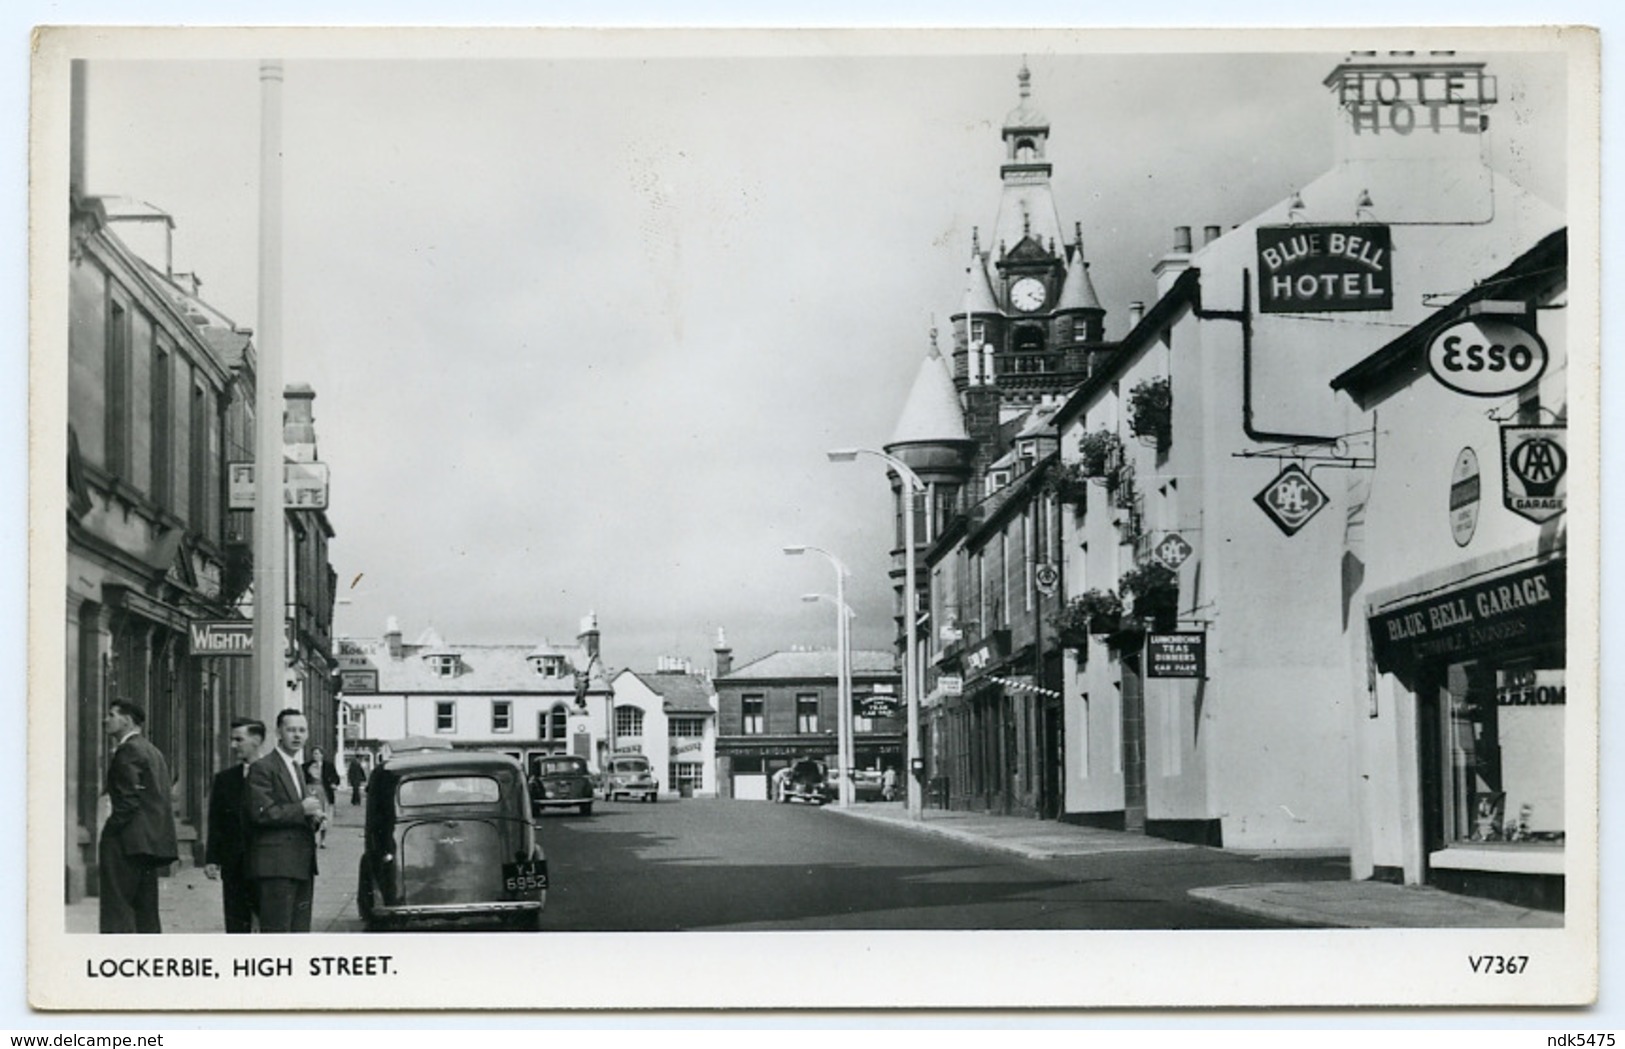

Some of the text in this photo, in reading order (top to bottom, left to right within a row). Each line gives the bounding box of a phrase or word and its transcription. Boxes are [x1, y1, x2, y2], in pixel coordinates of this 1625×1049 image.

[1340, 72, 1497, 105] HOTEL
[1262, 231, 1385, 271] BLUE BELL
[1271, 273, 1385, 299] HOTEL
[1516, 499, 1565, 510] GARAGE
[1387, 574, 1552, 641] BLUE BELL GARAGE
[1162, 644, 1189, 653] TEAS
[1154, 663, 1172, 671] CAR
[507, 875, 547, 891] 6952
